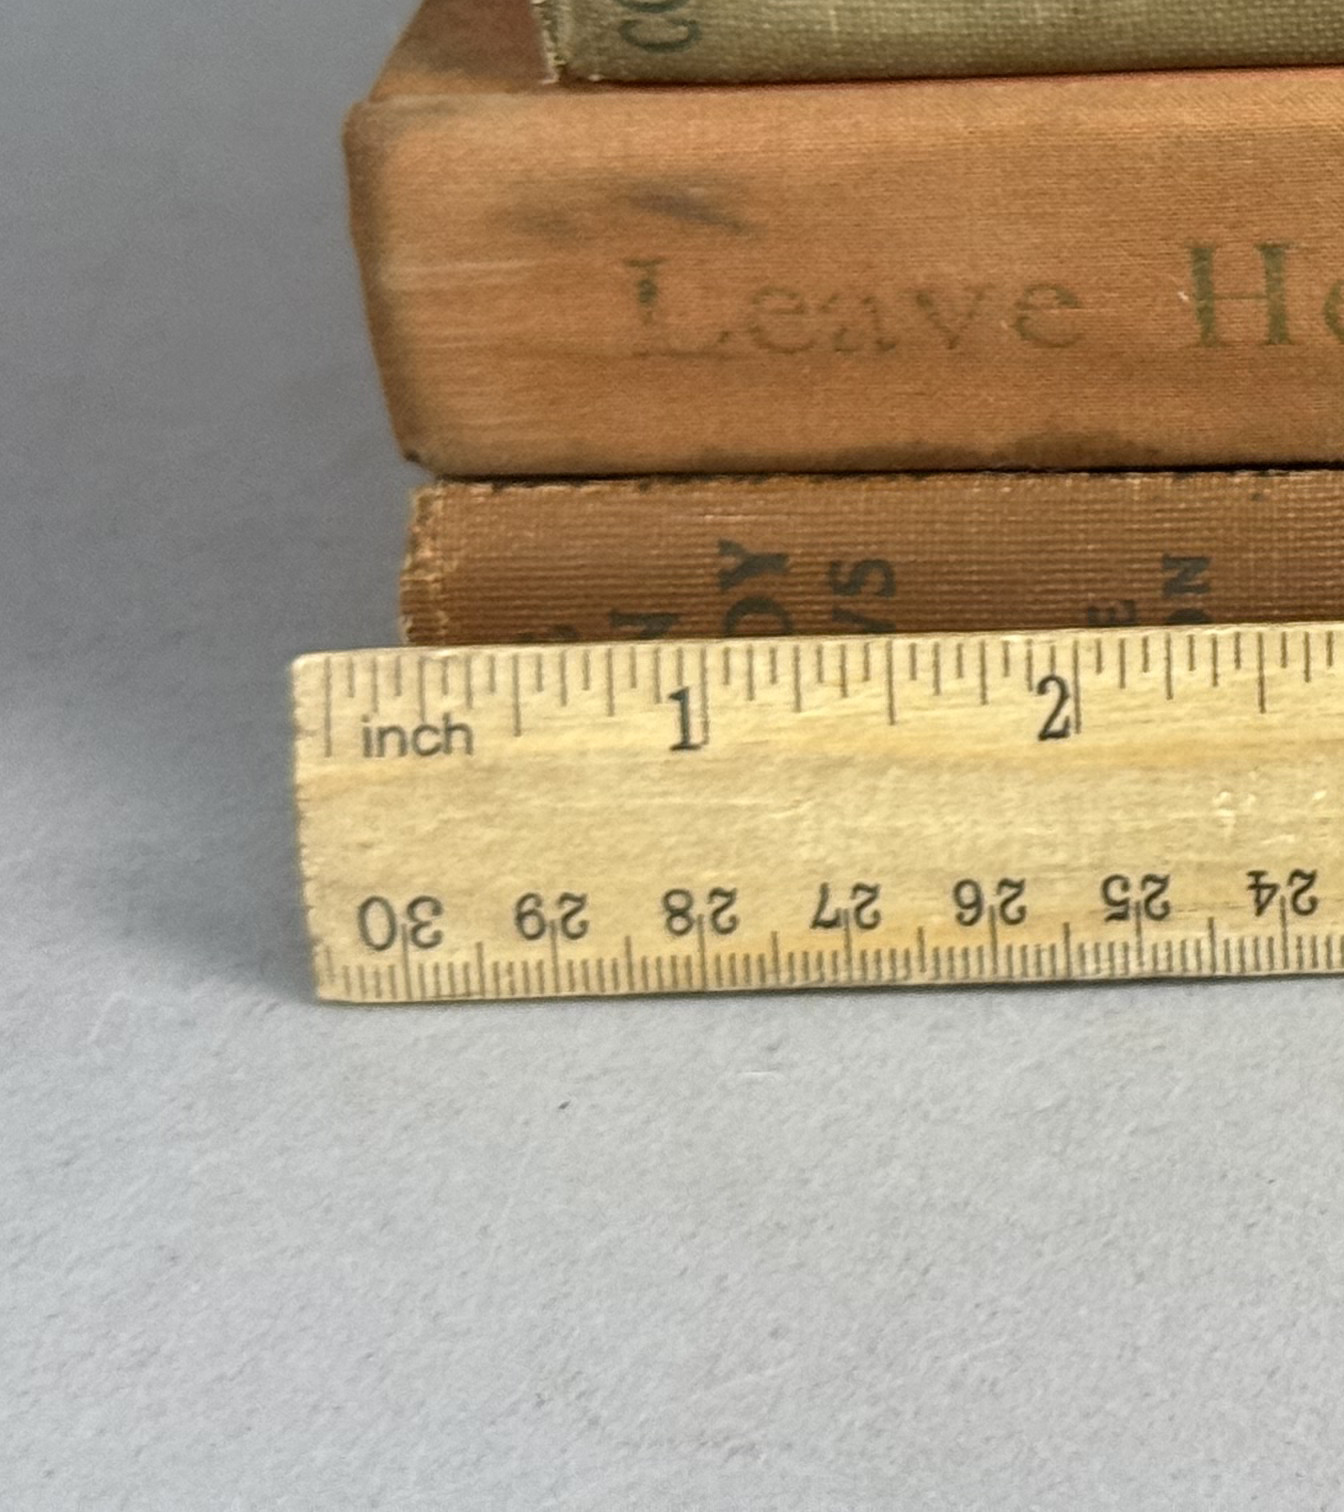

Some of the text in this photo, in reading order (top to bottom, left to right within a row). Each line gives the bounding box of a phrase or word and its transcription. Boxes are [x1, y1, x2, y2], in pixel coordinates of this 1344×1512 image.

[624, 256, 1085, 356] Leave
[361, 713, 474, 757] inch
[669, 687, 704, 751] 1
[1037, 674, 1071, 741] 2
[515, 892, 589, 940] 29
[662, 888, 739, 936] 28
[810, 882, 881, 931] 27
[953, 878, 1027, 927] 26
[1100, 874, 1171, 921] 25
[1247, 869, 1319, 917] 24
[357, 894, 444, 951] 30
